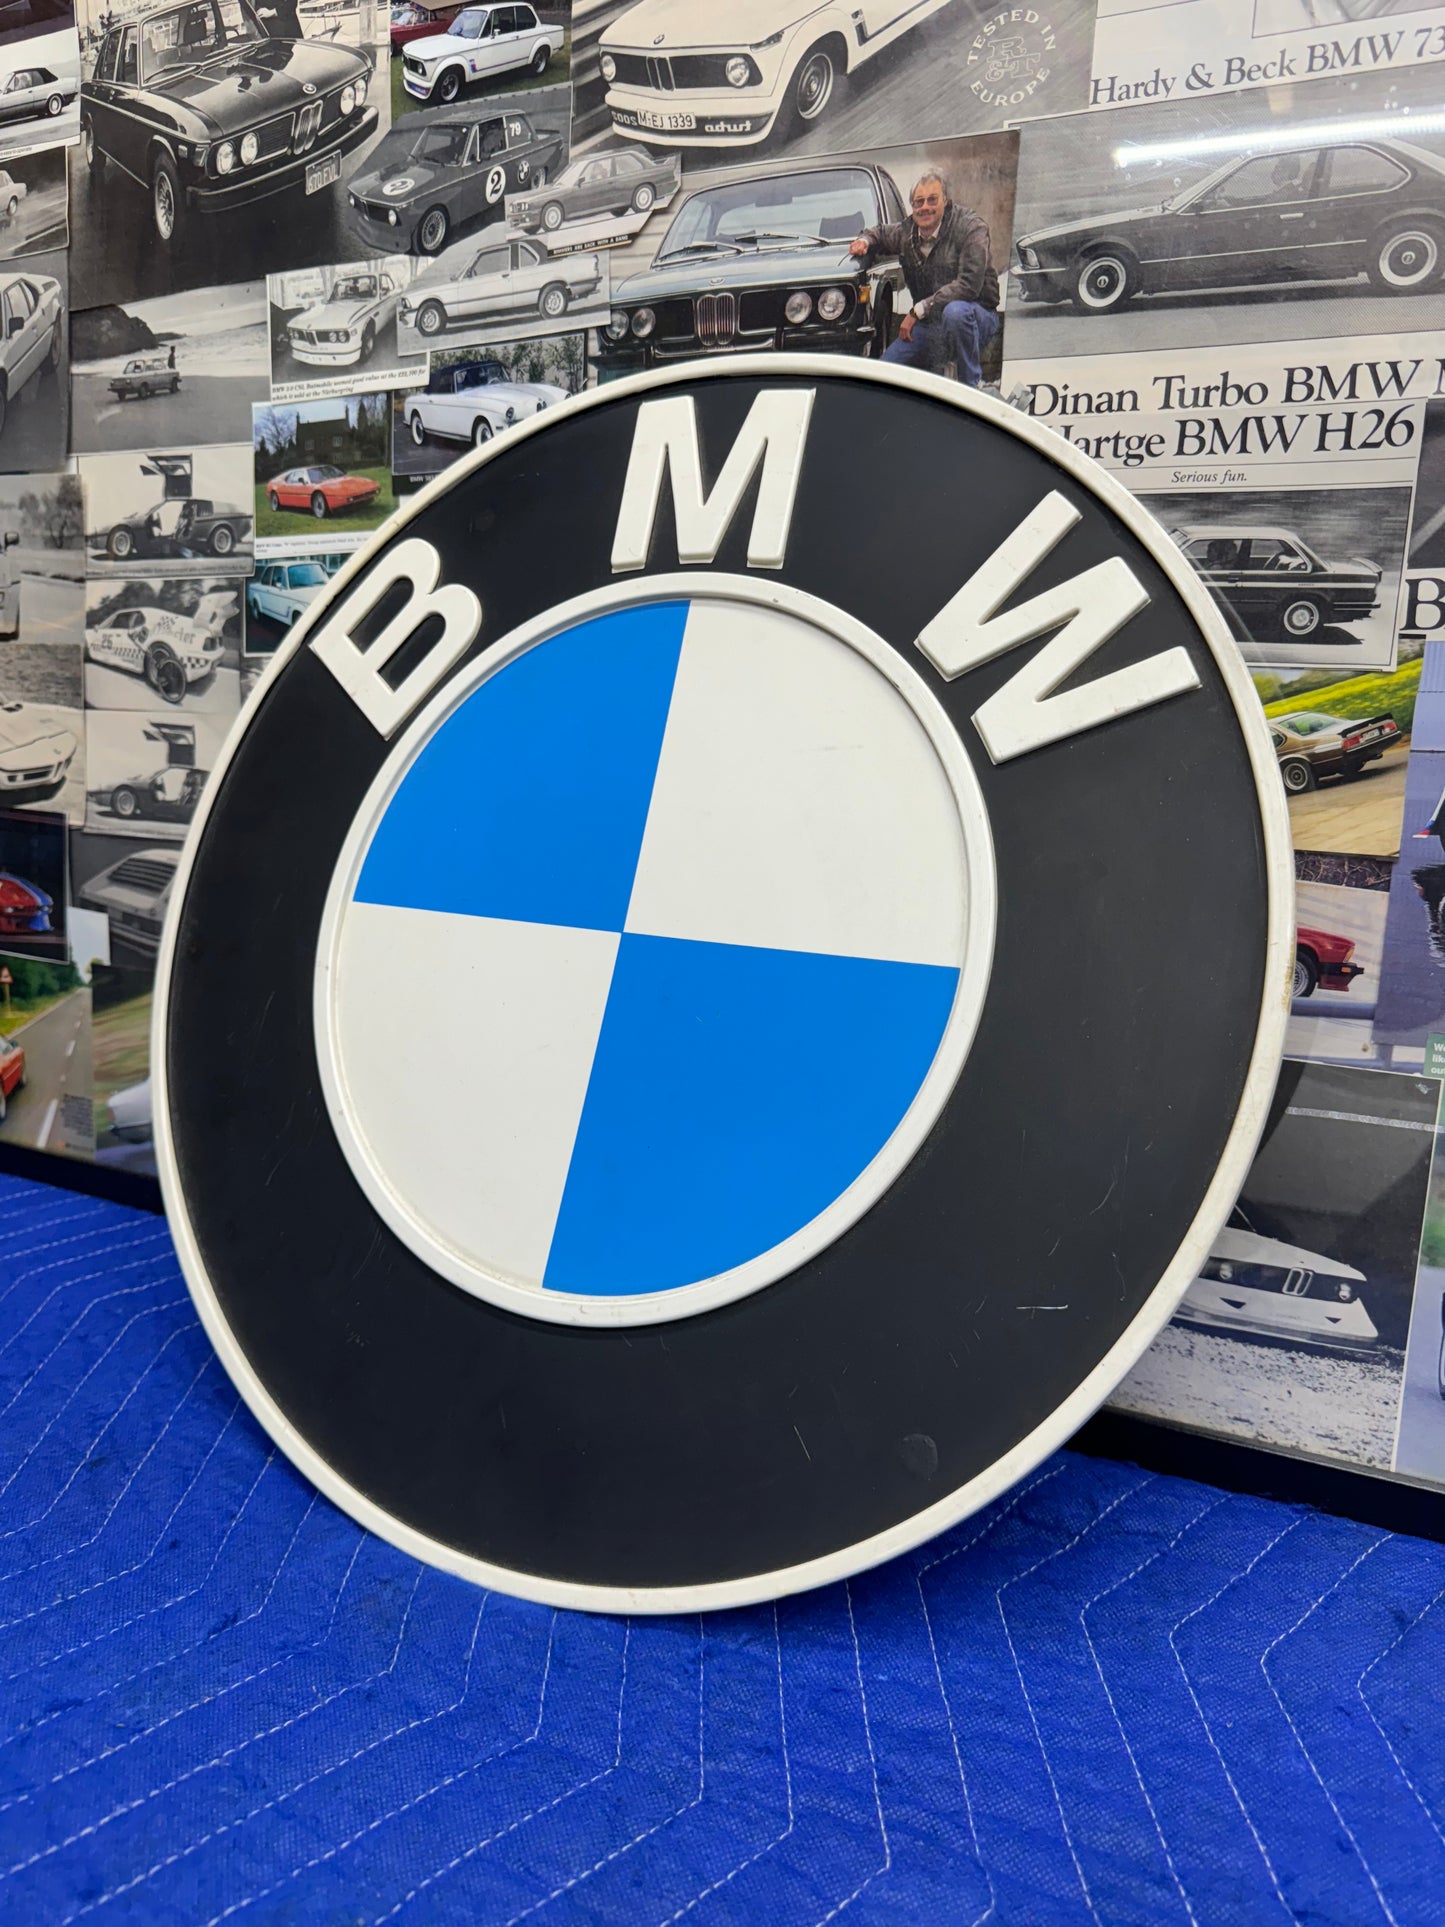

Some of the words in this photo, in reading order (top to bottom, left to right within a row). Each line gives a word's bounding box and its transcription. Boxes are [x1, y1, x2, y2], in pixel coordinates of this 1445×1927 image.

[967, 9, 1039, 65] TESTED
[1040, 24, 1056, 51] IN
[970, 67, 1050, 106] EUROPE
[1090, 68, 1177, 105] Hardy
[1185, 63, 1215, 91] &
[1223, 48, 1297, 86] Beck
[1305, 31, 1405, 74] BMW
[509, 121, 521, 137] 79
[668, 114, 693, 129] 1339
[490, 170, 502, 201] 2
[1027, 383, 1140, 417] Dinan
[1152, 370, 1269, 412] Turbo
[1280, 358, 1424, 404] BMW
[1172, 413, 1310, 457] BMW
[1313, 403, 1415, 453] H26
[1171, 471, 1218, 484] Serious
[1221, 469, 1247, 485] fun.
[308, 387, 1203, 767] BMW
